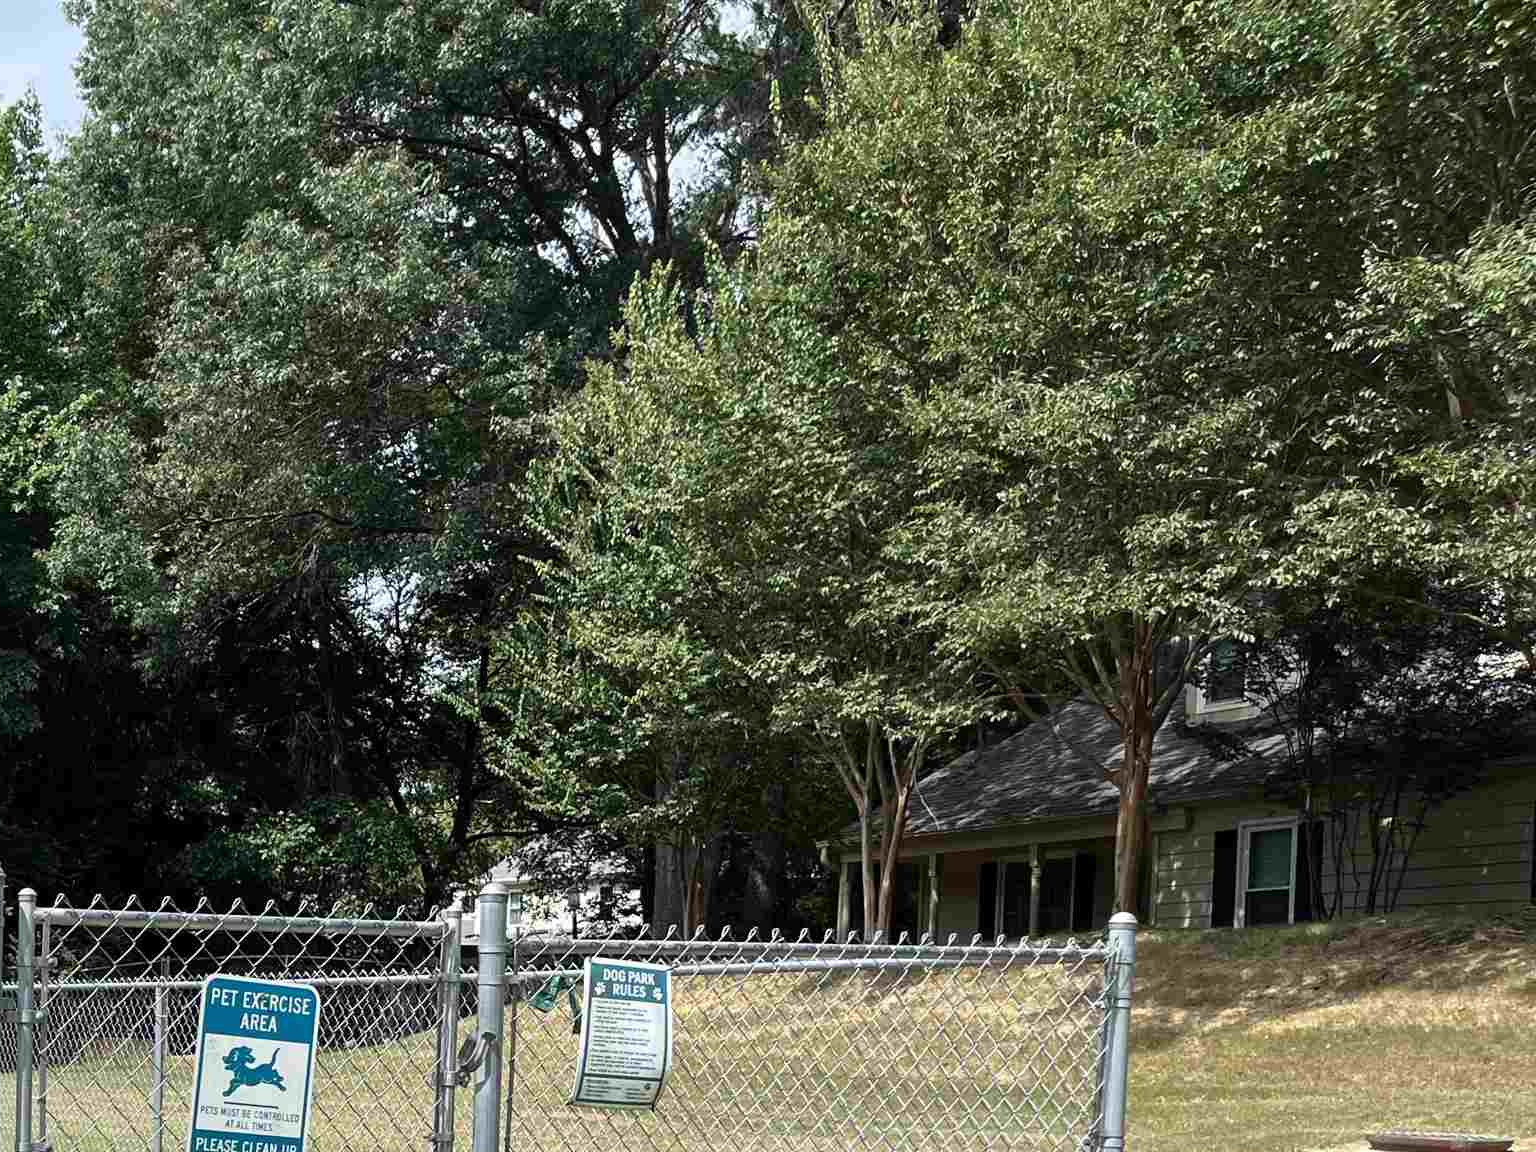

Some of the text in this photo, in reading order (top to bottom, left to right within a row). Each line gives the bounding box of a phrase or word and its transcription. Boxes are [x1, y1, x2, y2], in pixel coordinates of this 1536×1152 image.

[603, 968, 655, 985] DOG PARK
[613, 984, 646, 997] RULES
[211, 988, 311, 1015] PET EXERCISE
[240, 1013, 277, 1033] AREA
[200, 1105, 218, 1115] PETS
[221, 1107, 240, 1117] MUST
[254, 1110, 299, 1123] CONTROLLED
